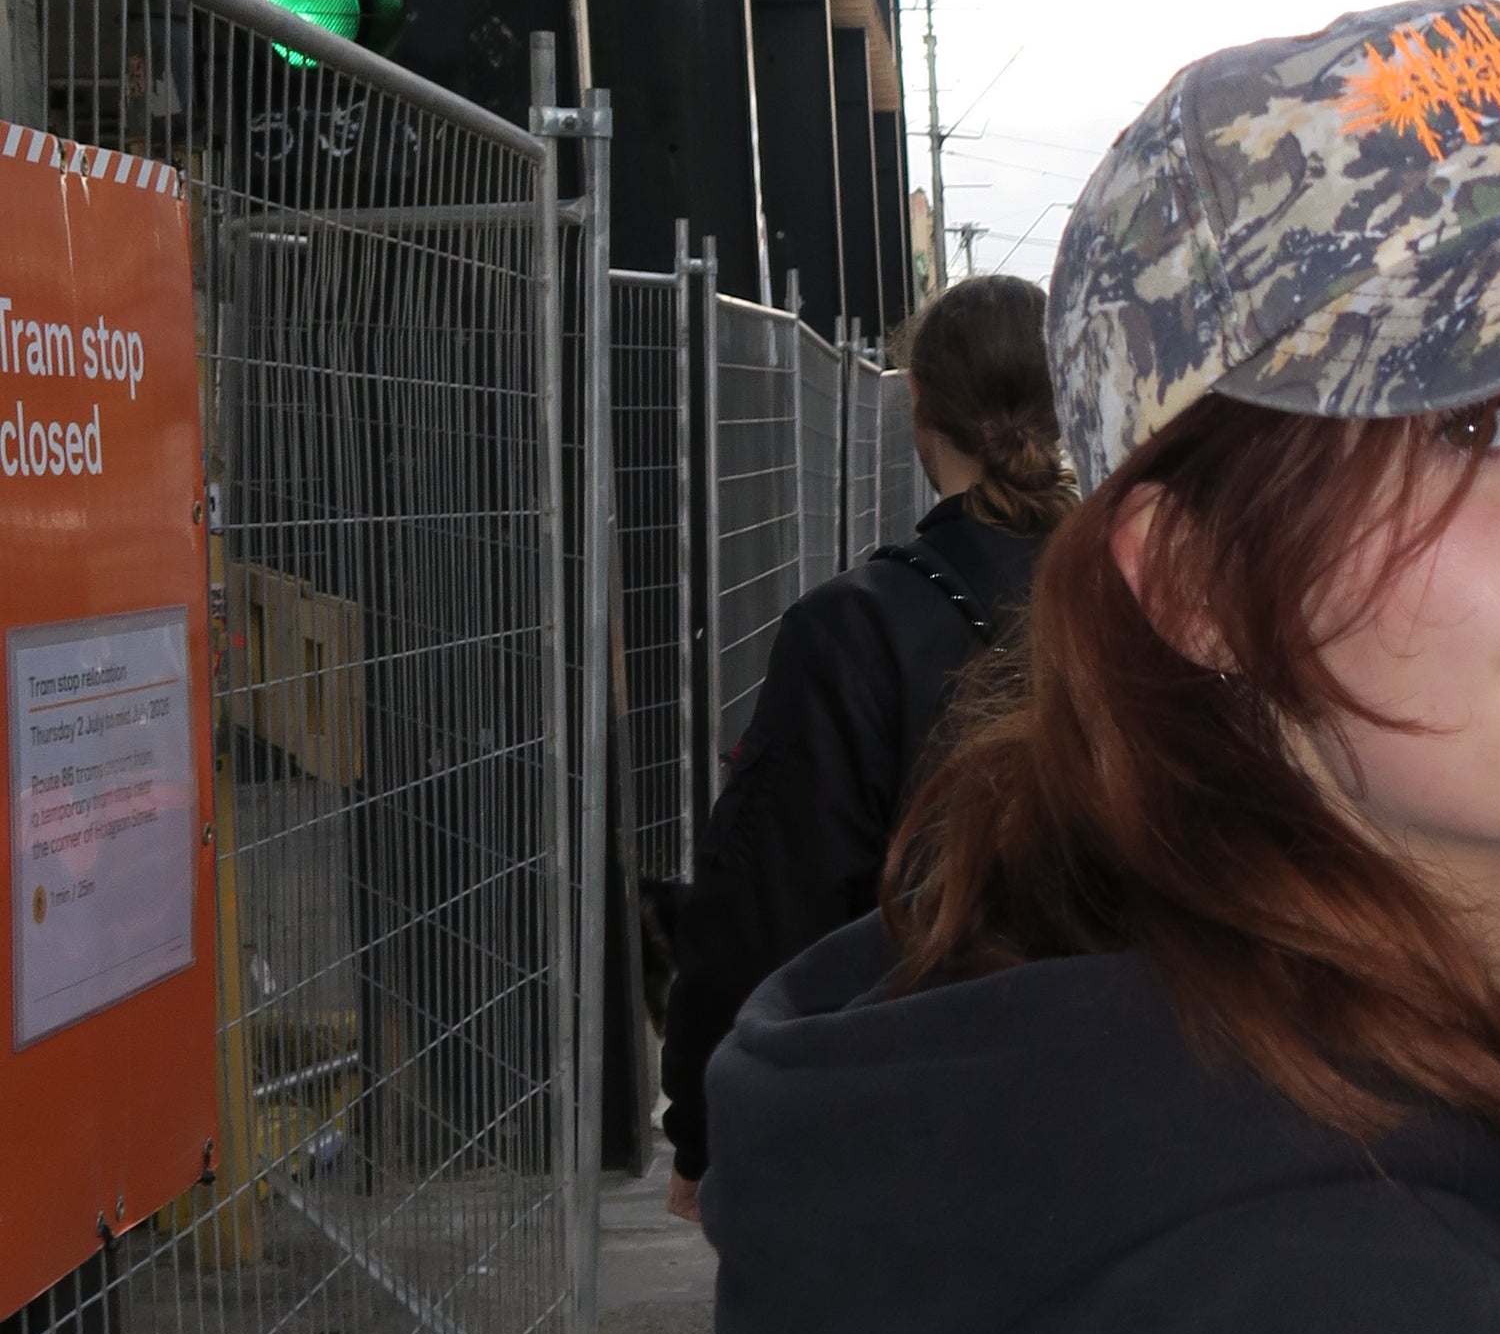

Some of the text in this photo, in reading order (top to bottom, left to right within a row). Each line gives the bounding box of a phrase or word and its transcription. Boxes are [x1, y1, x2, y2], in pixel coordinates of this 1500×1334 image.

[0, 296, 145, 400] Tram stop
[0, 400, 103, 477] closed
[28, 665, 128, 698] Tram stop relocation
[30, 721, 74, 746] Thursday
[77, 715, 84, 737] 2
[85, 712, 104, 737] July
[31, 773, 60, 796] Route
[61, 766, 75, 788] 86
[41, 798, 91, 826] temporary
[32, 840, 49, 859] the
[50, 831, 82, 854] corner
[83, 820, 95, 844] of
